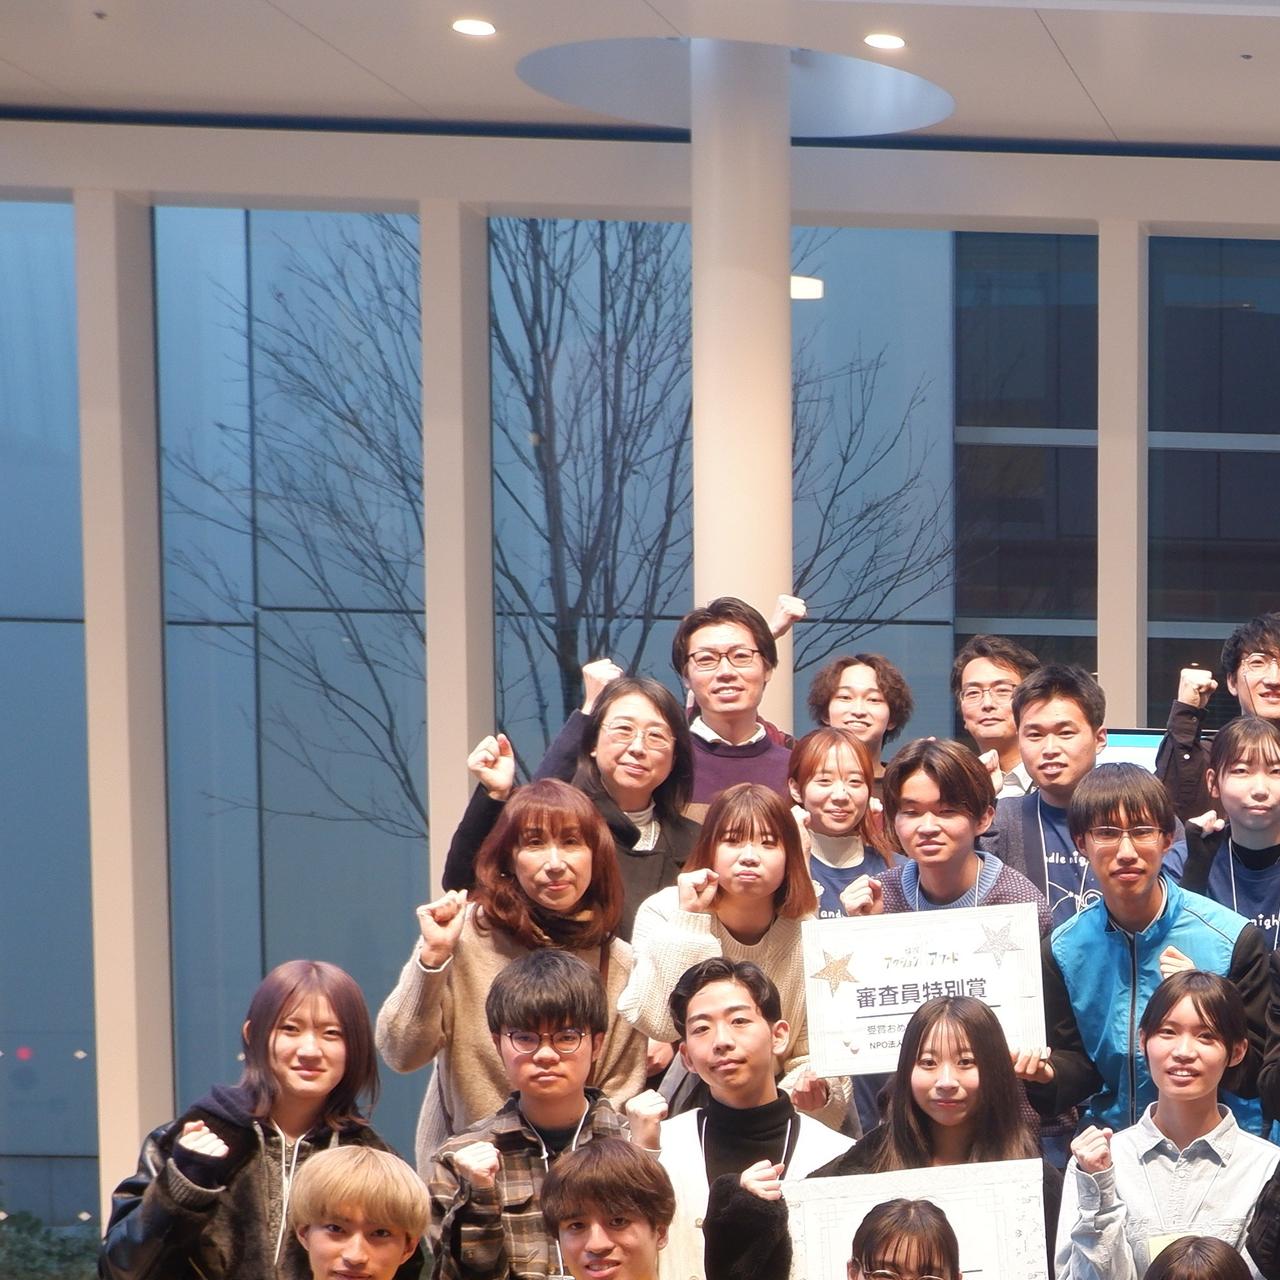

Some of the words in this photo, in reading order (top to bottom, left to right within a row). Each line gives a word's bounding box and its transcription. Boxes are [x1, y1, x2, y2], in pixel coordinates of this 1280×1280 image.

[856, 977, 987, 1009] 審査員特別賞
[867, 1022, 906, 1035] 受賞おめ
[869, 1039, 903, 1050] NPO法人
